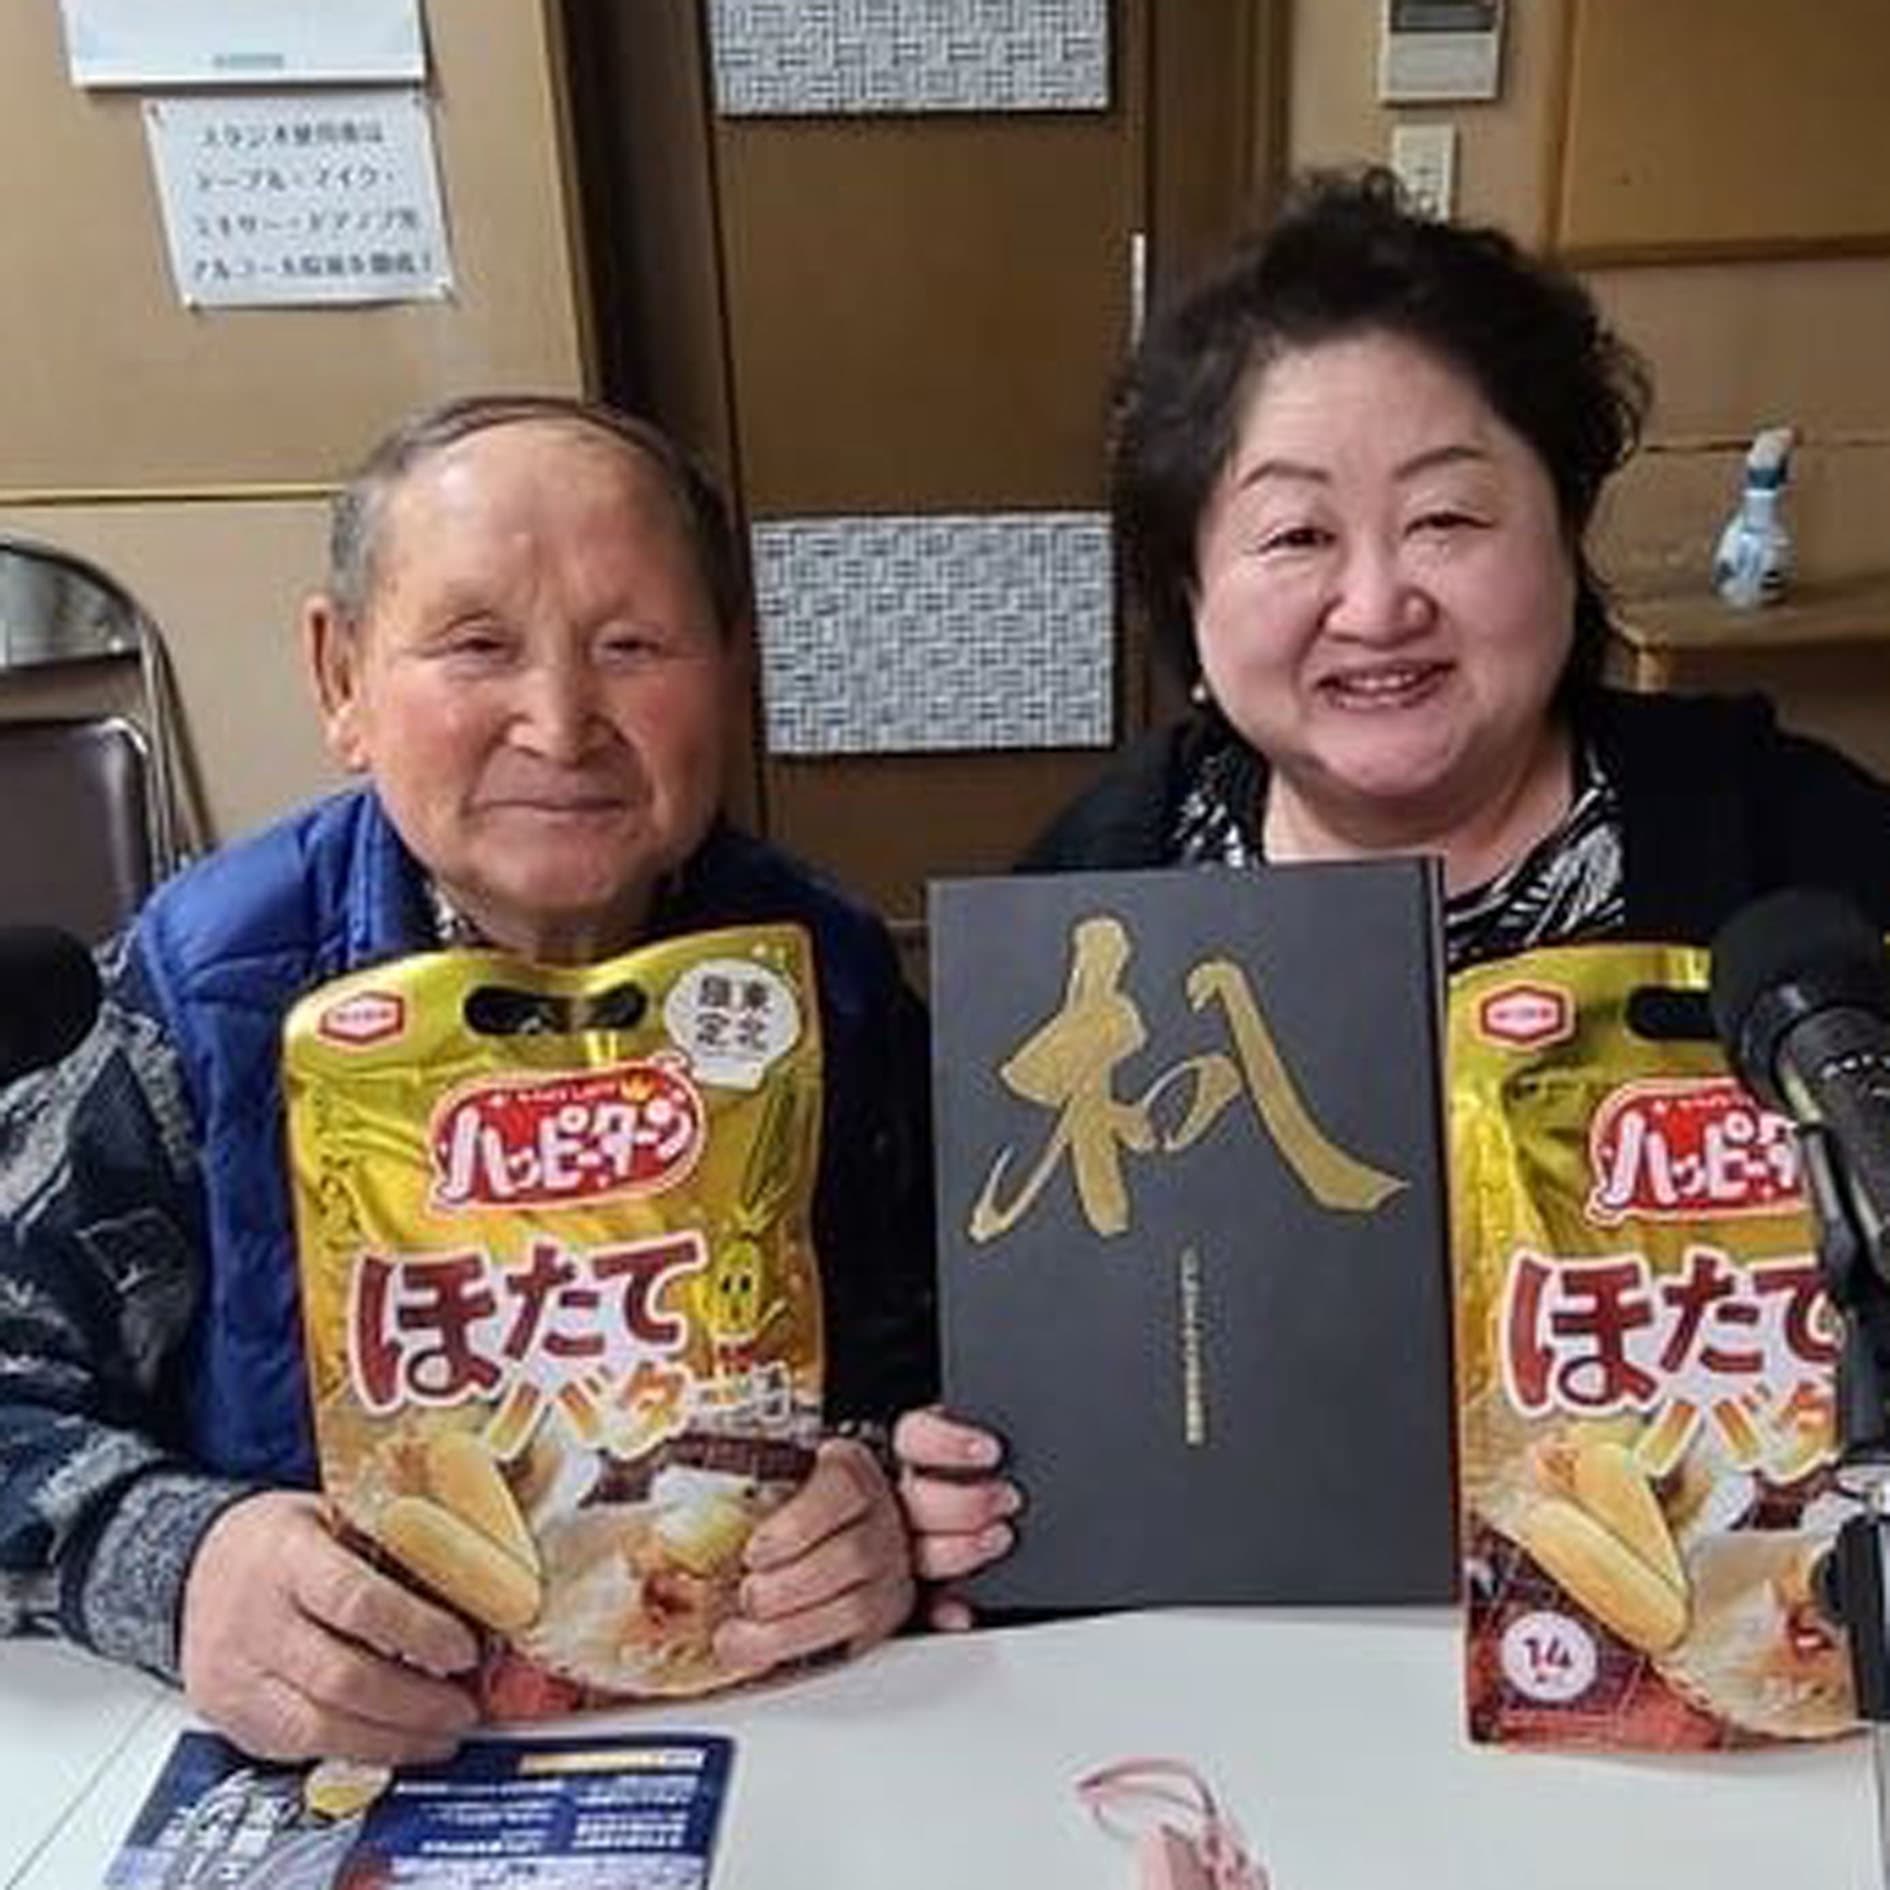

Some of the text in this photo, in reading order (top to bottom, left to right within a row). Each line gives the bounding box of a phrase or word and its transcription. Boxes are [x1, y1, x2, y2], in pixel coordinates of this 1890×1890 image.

[440, 1097, 693, 1198] ハッピーターン
[358, 1241, 700, 1406] ほたて
[1522, 1636, 1574, 1669] 14
